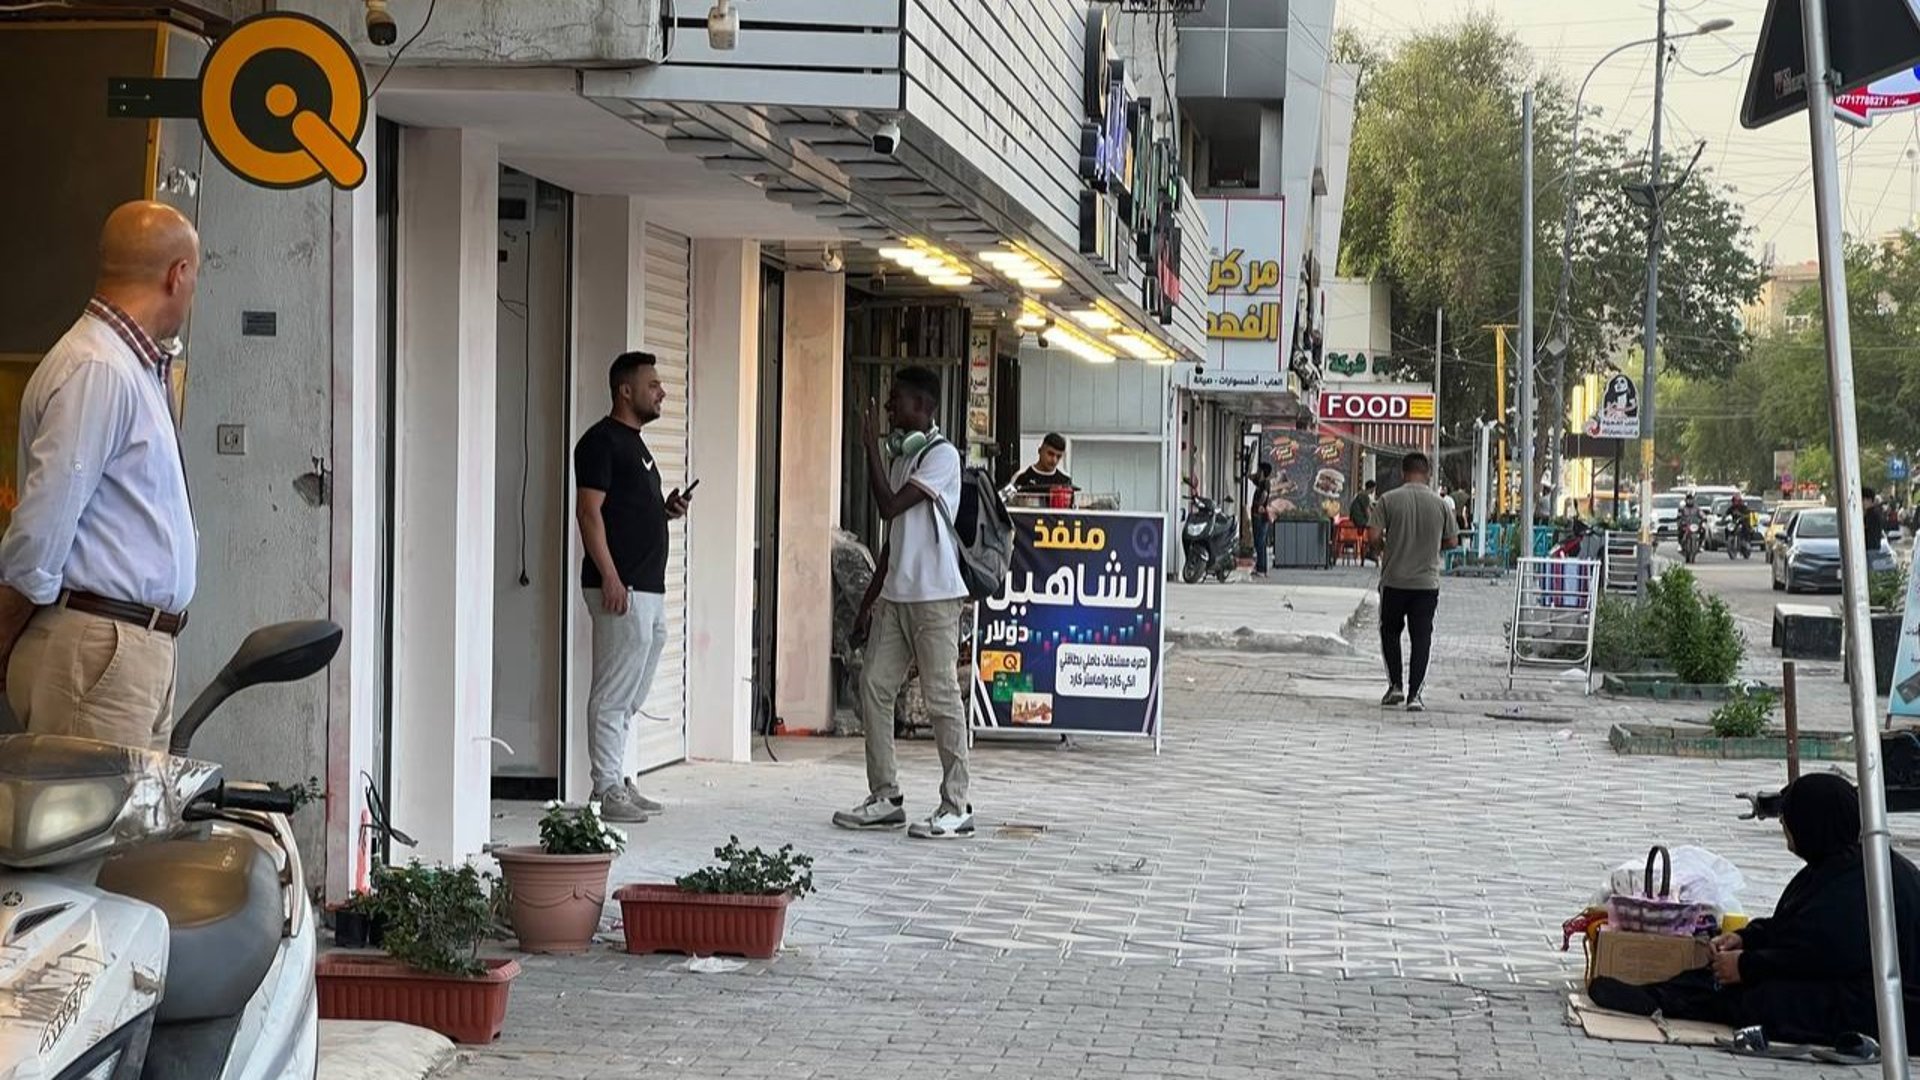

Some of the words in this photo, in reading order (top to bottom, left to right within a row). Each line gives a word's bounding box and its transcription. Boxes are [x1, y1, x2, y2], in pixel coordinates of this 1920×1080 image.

[201, 12, 368, 190] Q
[1328, 395, 1407, 417] FOOD
[1033, 518, 1106, 551] منفذ
[984, 620, 1029, 646] دولار
